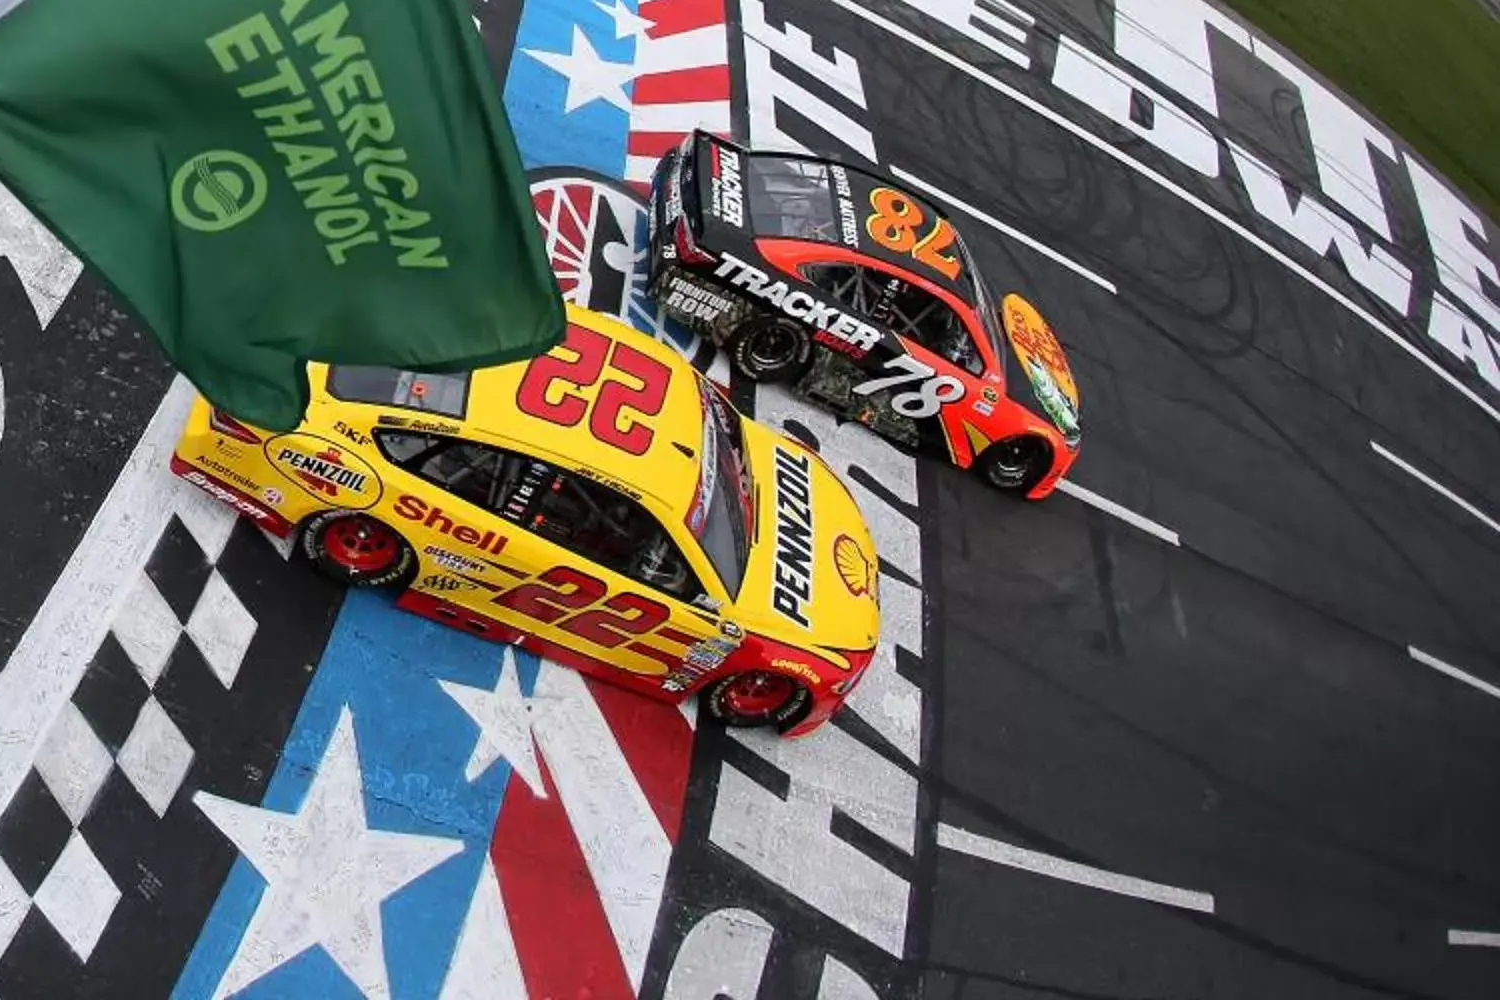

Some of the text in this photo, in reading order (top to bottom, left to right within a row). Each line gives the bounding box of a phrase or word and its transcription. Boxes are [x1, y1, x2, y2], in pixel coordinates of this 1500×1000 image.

[205, 12, 379, 267] ETHANOL
[717, 145, 744, 229] TRACKER
[662, 244, 678, 260] 78
[866, 187, 963, 281] 78
[665, 290, 719, 324] ROW
[669, 276, 734, 312] FURNITURE
[713, 252, 886, 355] TRACKER
[516, 322, 673, 457] 22
[852, 354, 967, 420] 78
[276, 446, 367, 495] PENNZOIL
[332, 420, 373, 447] SKF
[392, 494, 509, 557] Shell
[773, 446, 813, 630] PENNZOIL
[502, 565, 672, 648] 22
